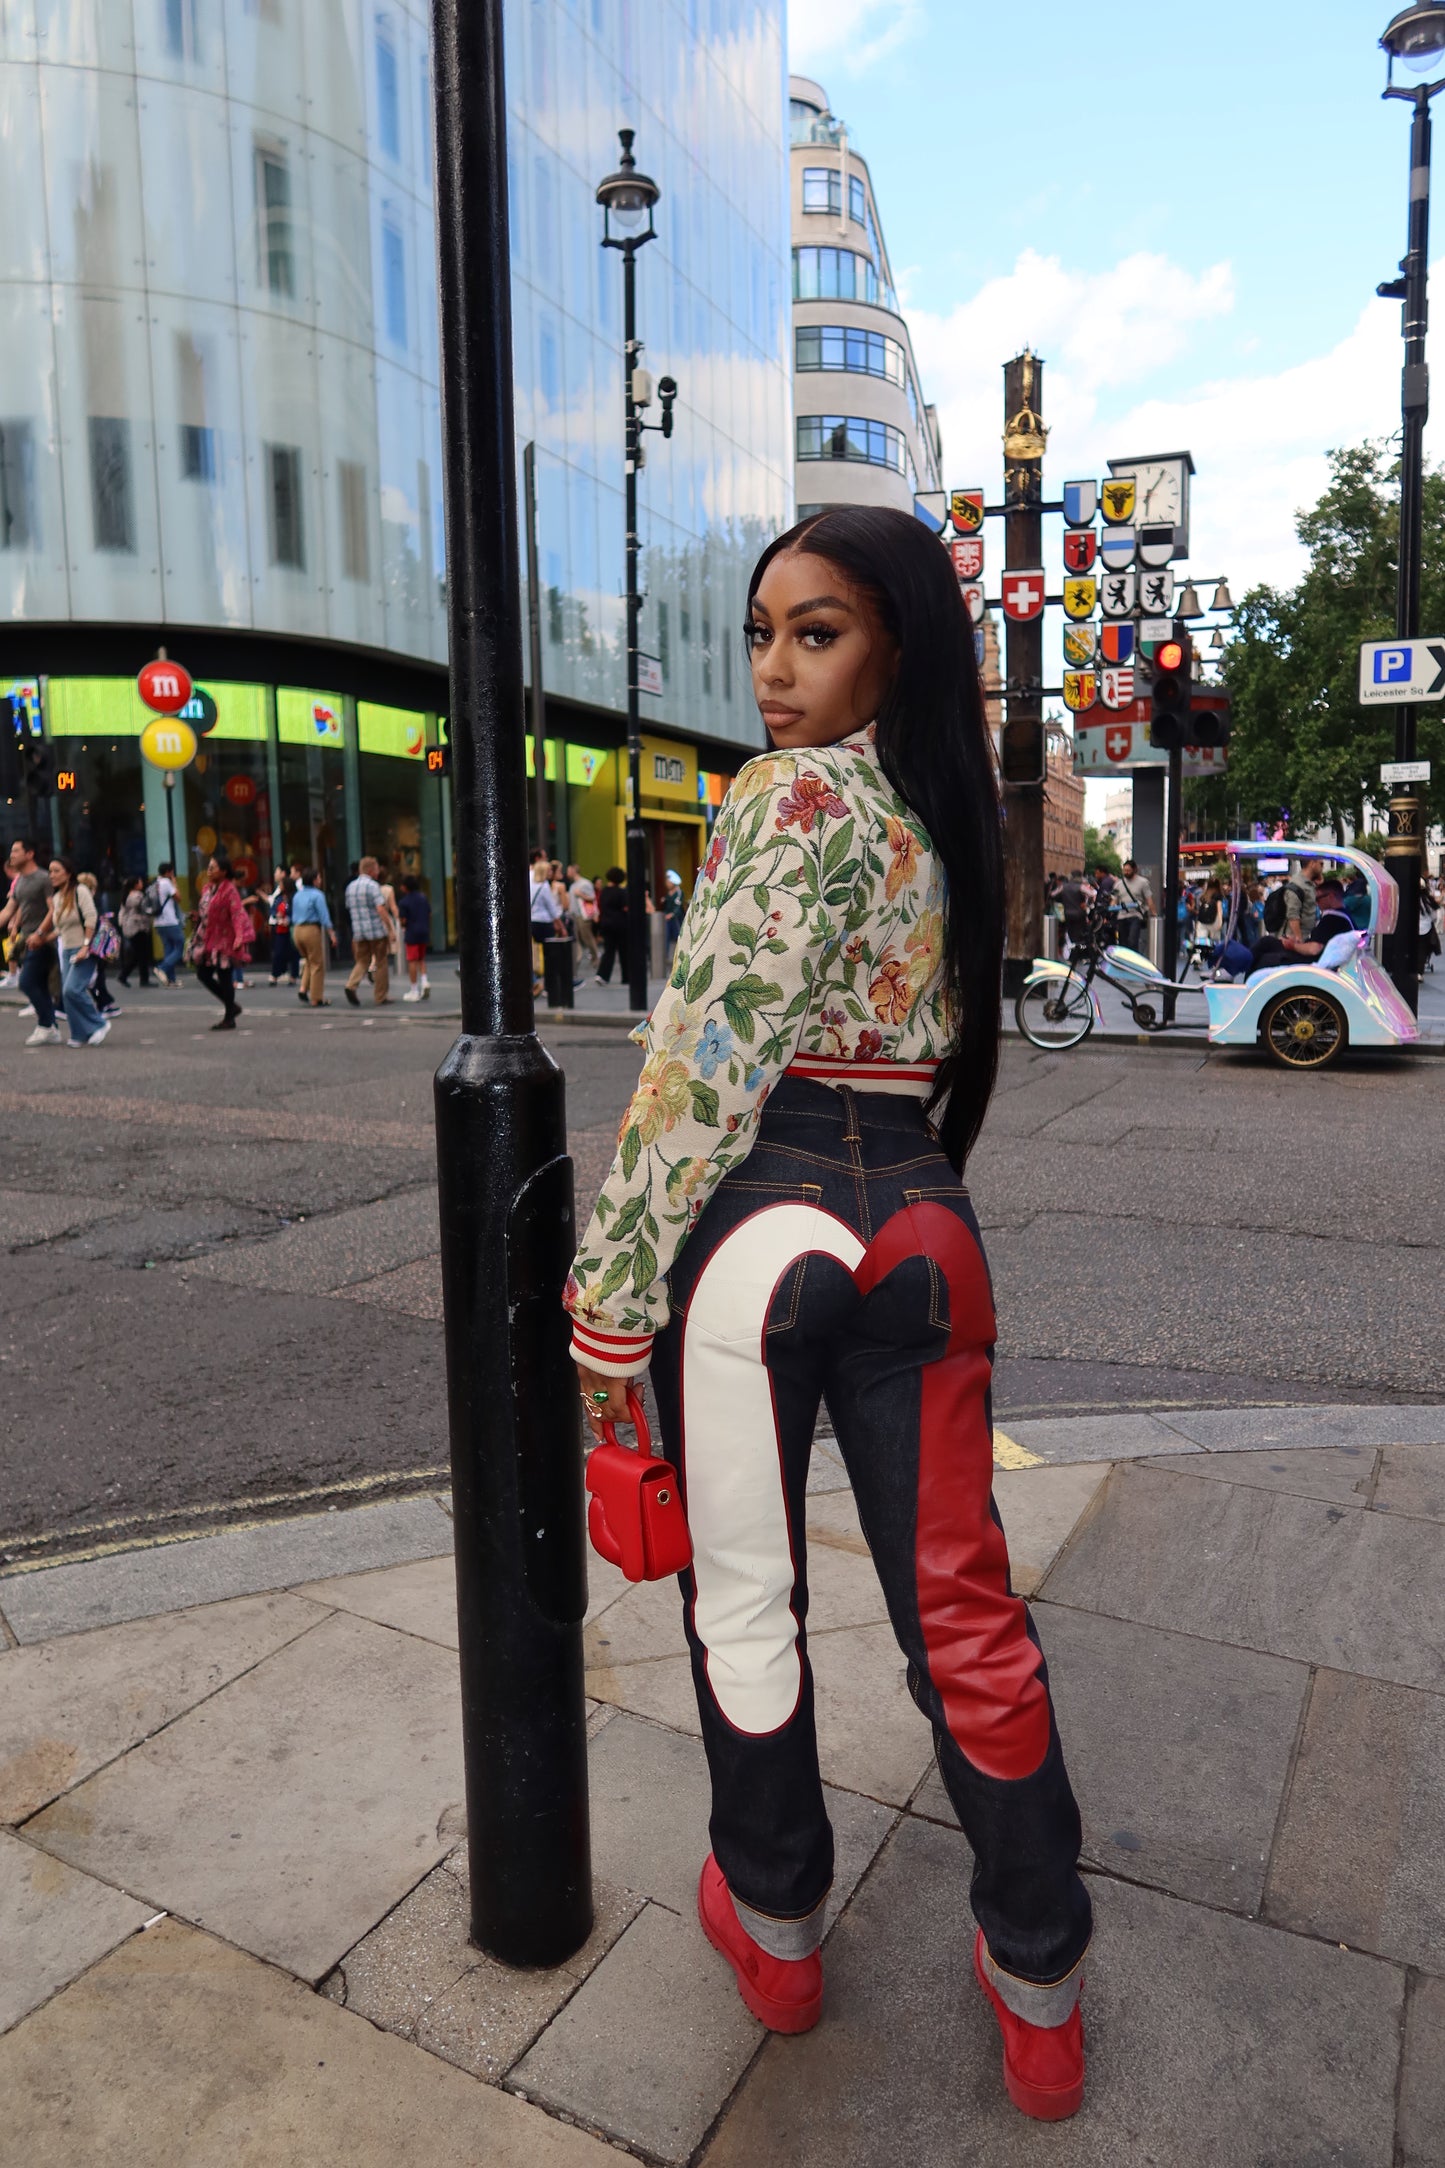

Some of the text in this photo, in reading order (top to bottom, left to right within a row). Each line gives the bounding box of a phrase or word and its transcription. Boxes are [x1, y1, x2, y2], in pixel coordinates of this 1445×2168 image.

[1380, 650, 1405, 681] P
[151, 675, 180, 697] m
[1363, 687, 1424, 699] Leicester Sq
[155, 732, 183, 754] m
[428, 750, 443, 770] 04
[57, 772, 75, 790] 04
